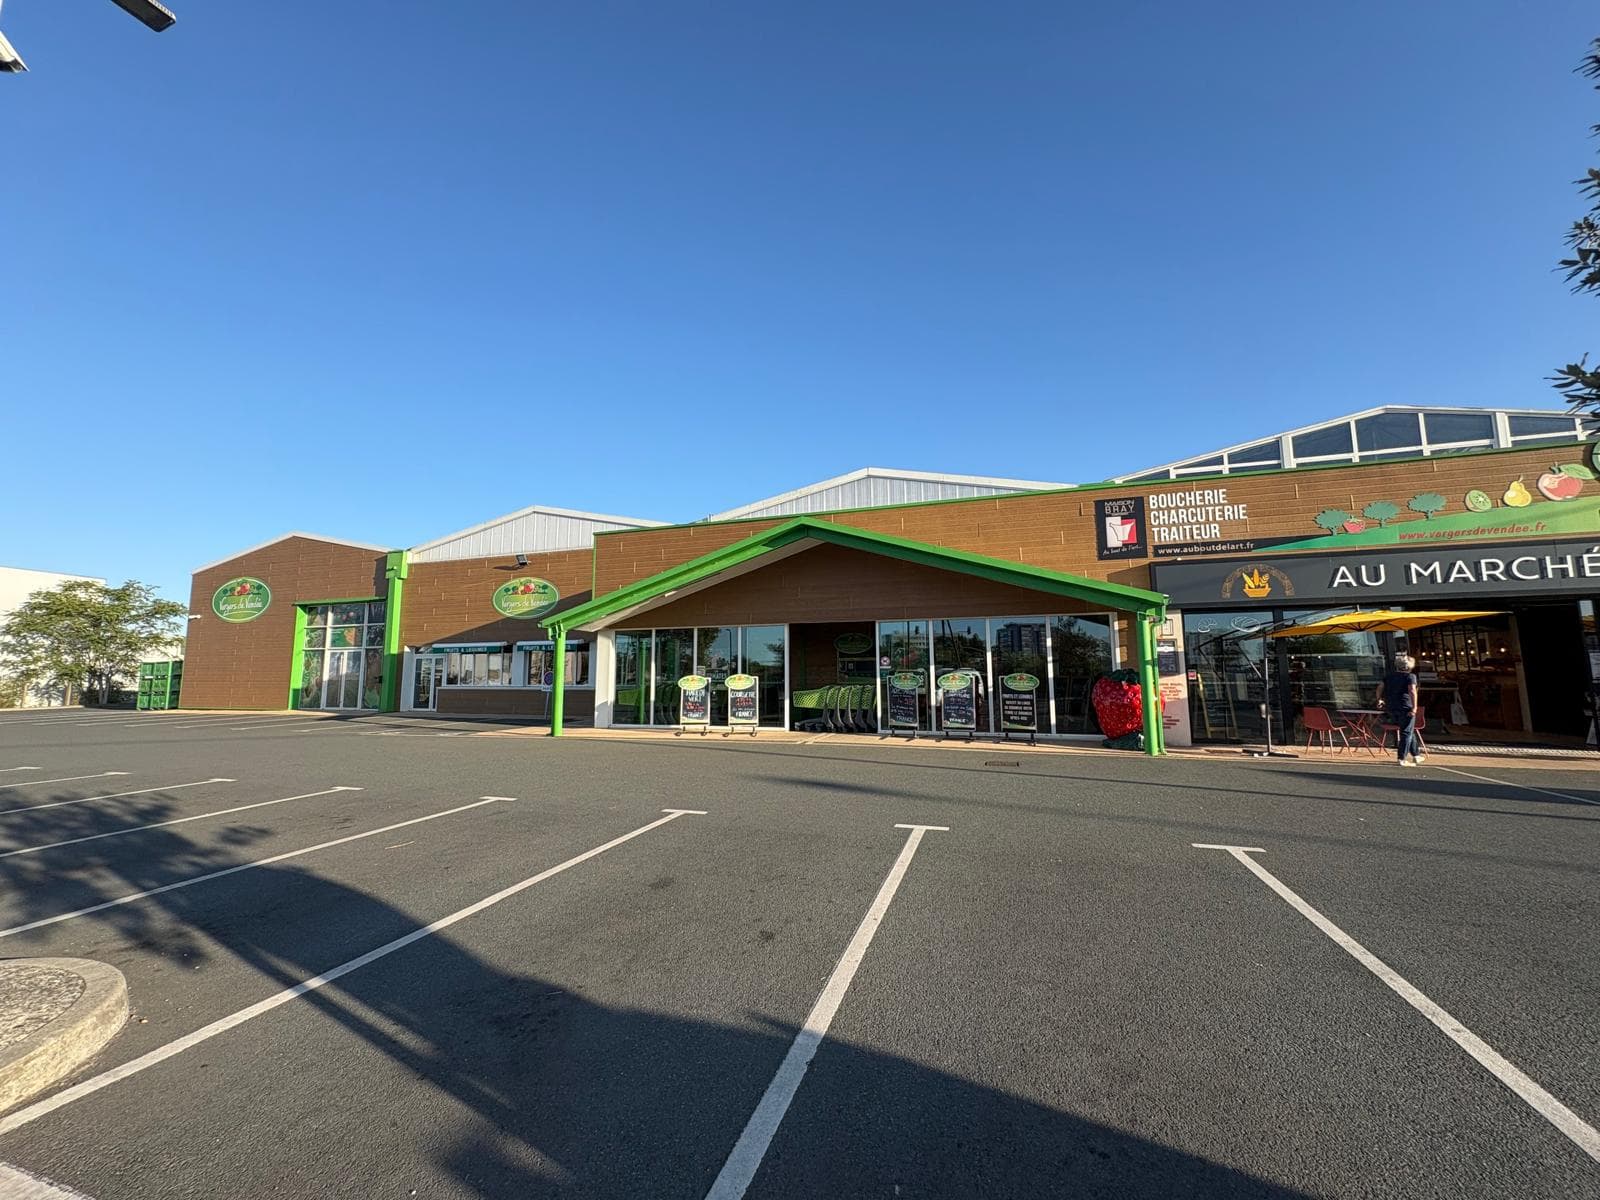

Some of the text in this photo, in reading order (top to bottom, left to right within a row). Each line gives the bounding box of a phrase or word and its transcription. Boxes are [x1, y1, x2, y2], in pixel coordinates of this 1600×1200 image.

[1149, 489, 1228, 509] BOUCHERIE
[1105, 505, 1134, 513] BRAY
[1150, 504, 1248, 525] CHARCUTERIE
[1152, 523, 1220, 542] TRAITEUR
[1398, 522, 1547, 540] www.vergersdevendee.fr
[1158, 541, 1255, 554] www.auboutdelart.fr
[1331, 563, 1386, 587] AU
[1410, 545, 1600, 584] MARCHÉ
[219, 596, 237, 616] Vergers
[237, 597, 245, 608] de
